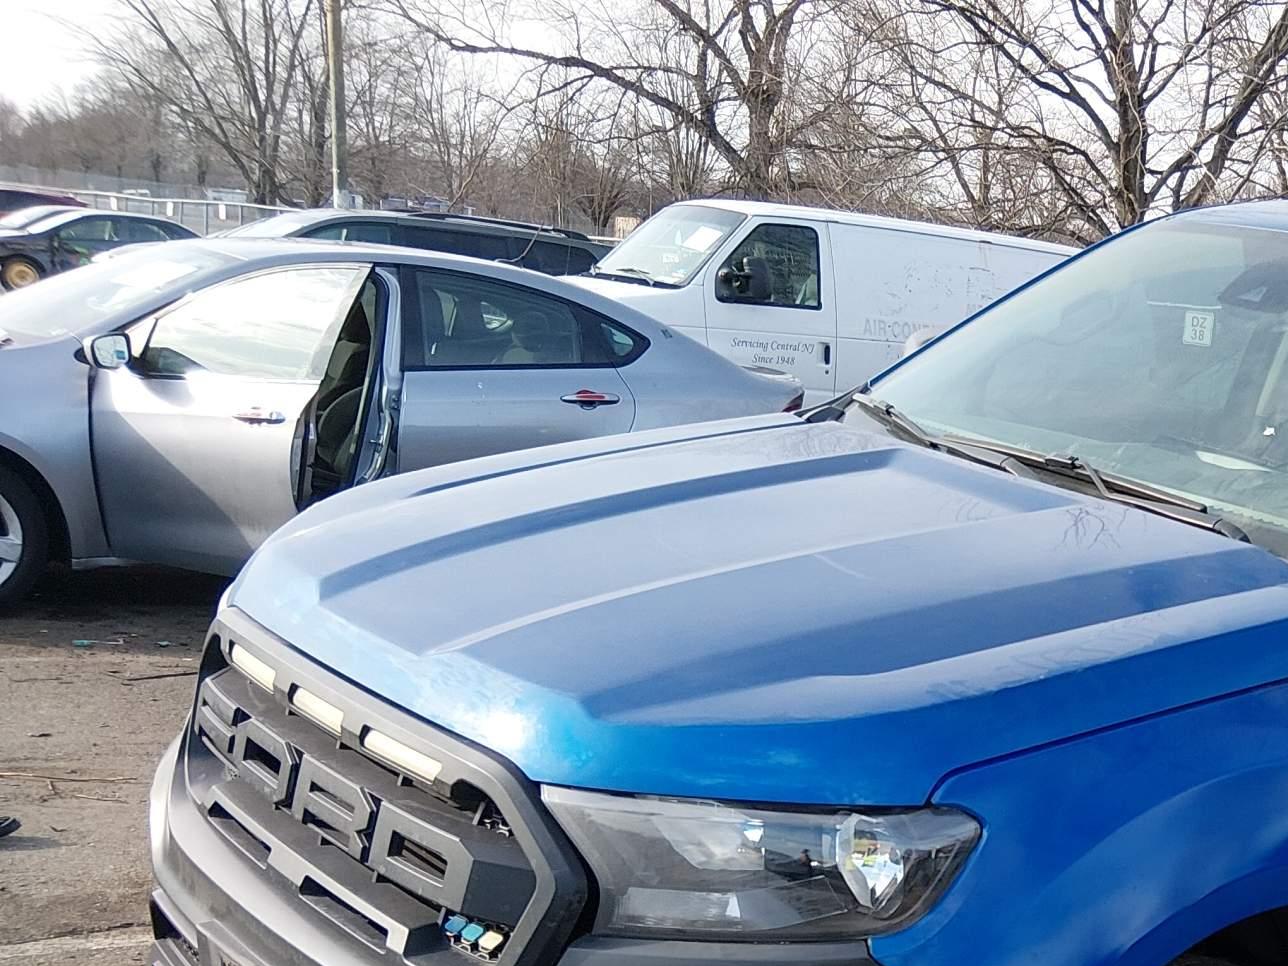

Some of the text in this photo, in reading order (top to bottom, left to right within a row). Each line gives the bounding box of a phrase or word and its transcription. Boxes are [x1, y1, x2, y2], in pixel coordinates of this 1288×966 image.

[863, 319, 887, 337] AIR
[1191, 328, 1205, 341] 38
[731, 337, 815, 354] Servicing Central NJ
[752, 352, 796, 366] Since 1948
